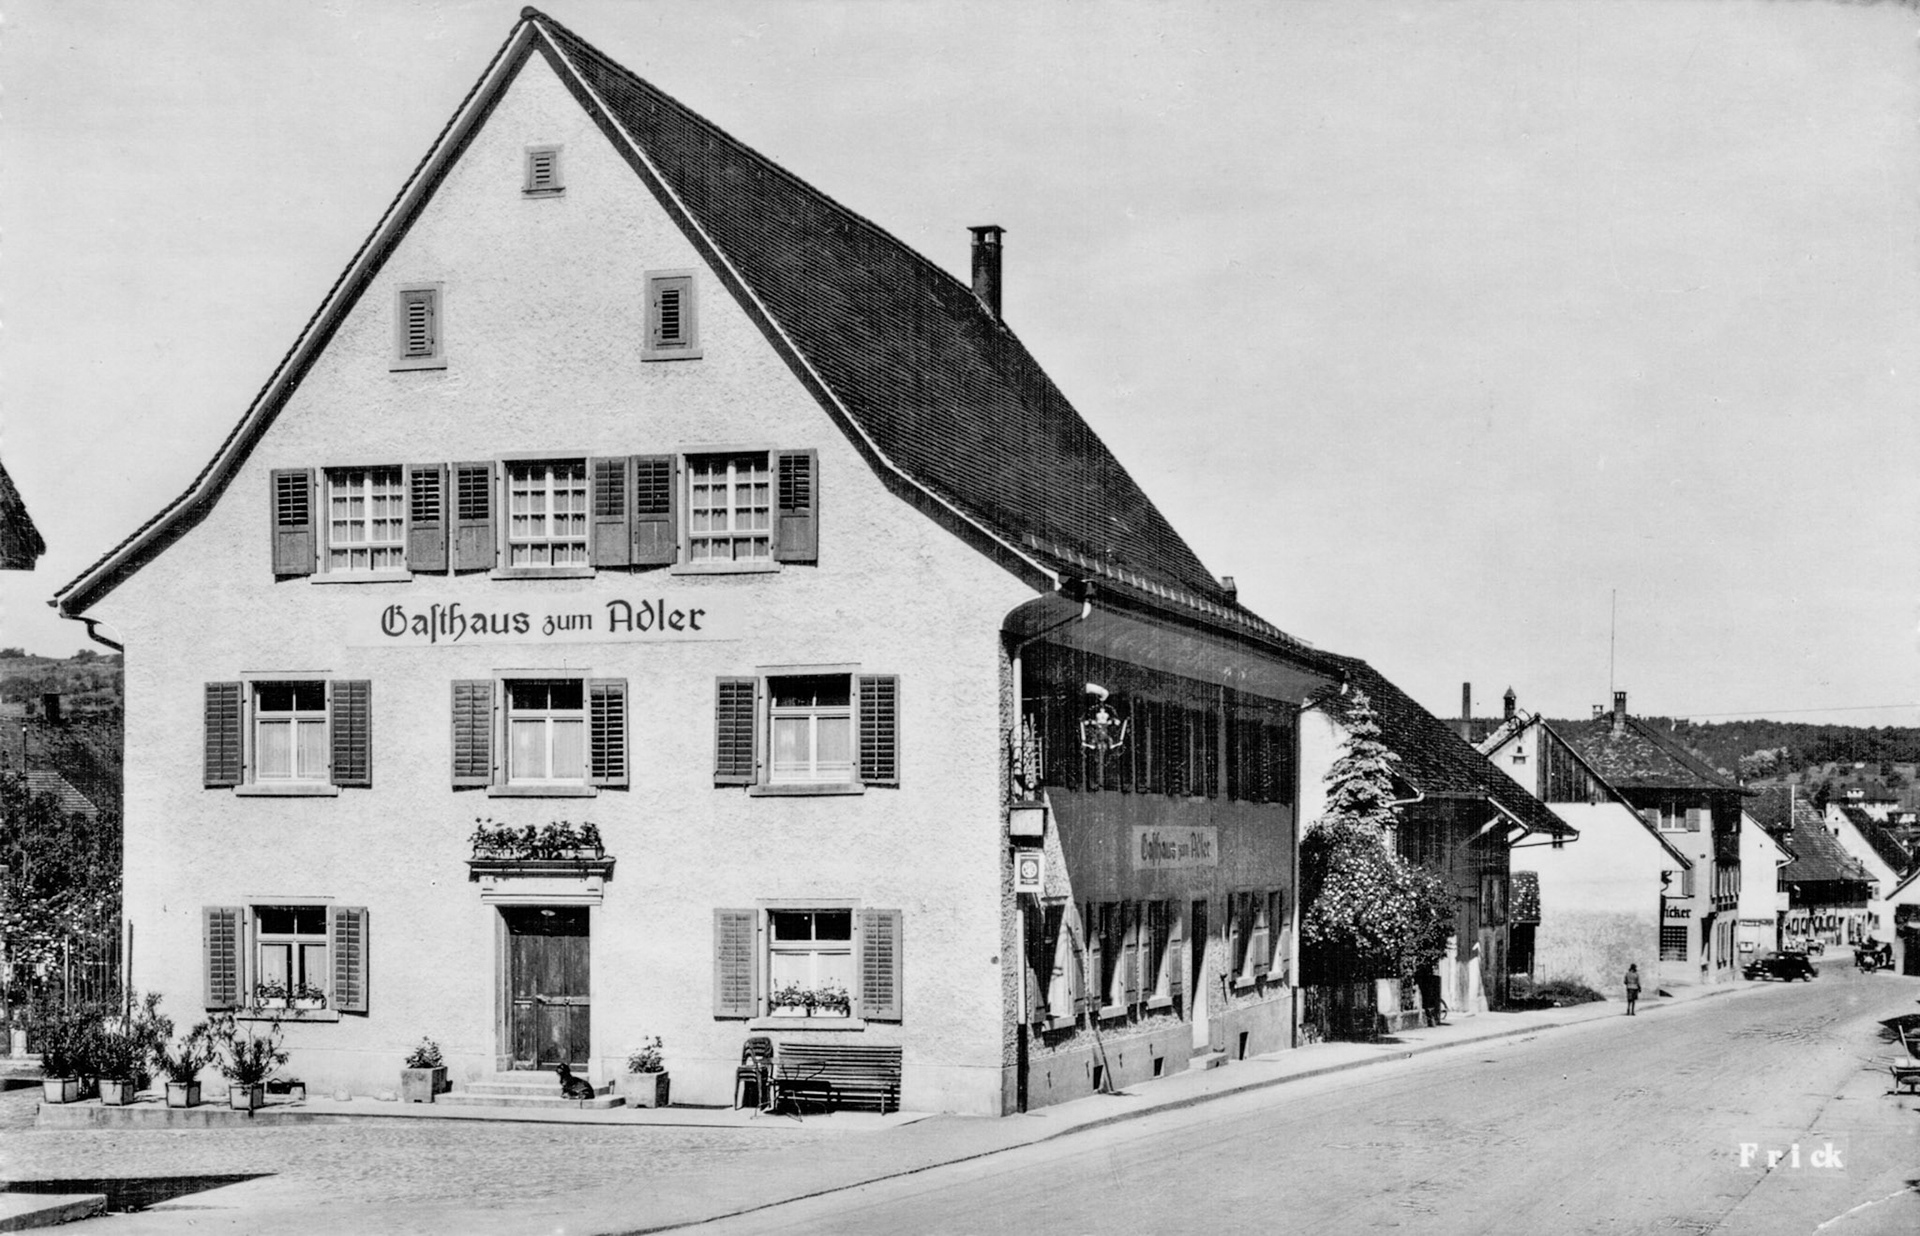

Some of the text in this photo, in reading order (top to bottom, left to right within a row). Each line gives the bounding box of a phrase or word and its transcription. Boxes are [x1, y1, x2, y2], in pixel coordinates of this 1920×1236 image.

[542, 613, 593, 636] zum
[606, 599, 706, 632] Adler
[1665, 905, 1691, 918] icker
